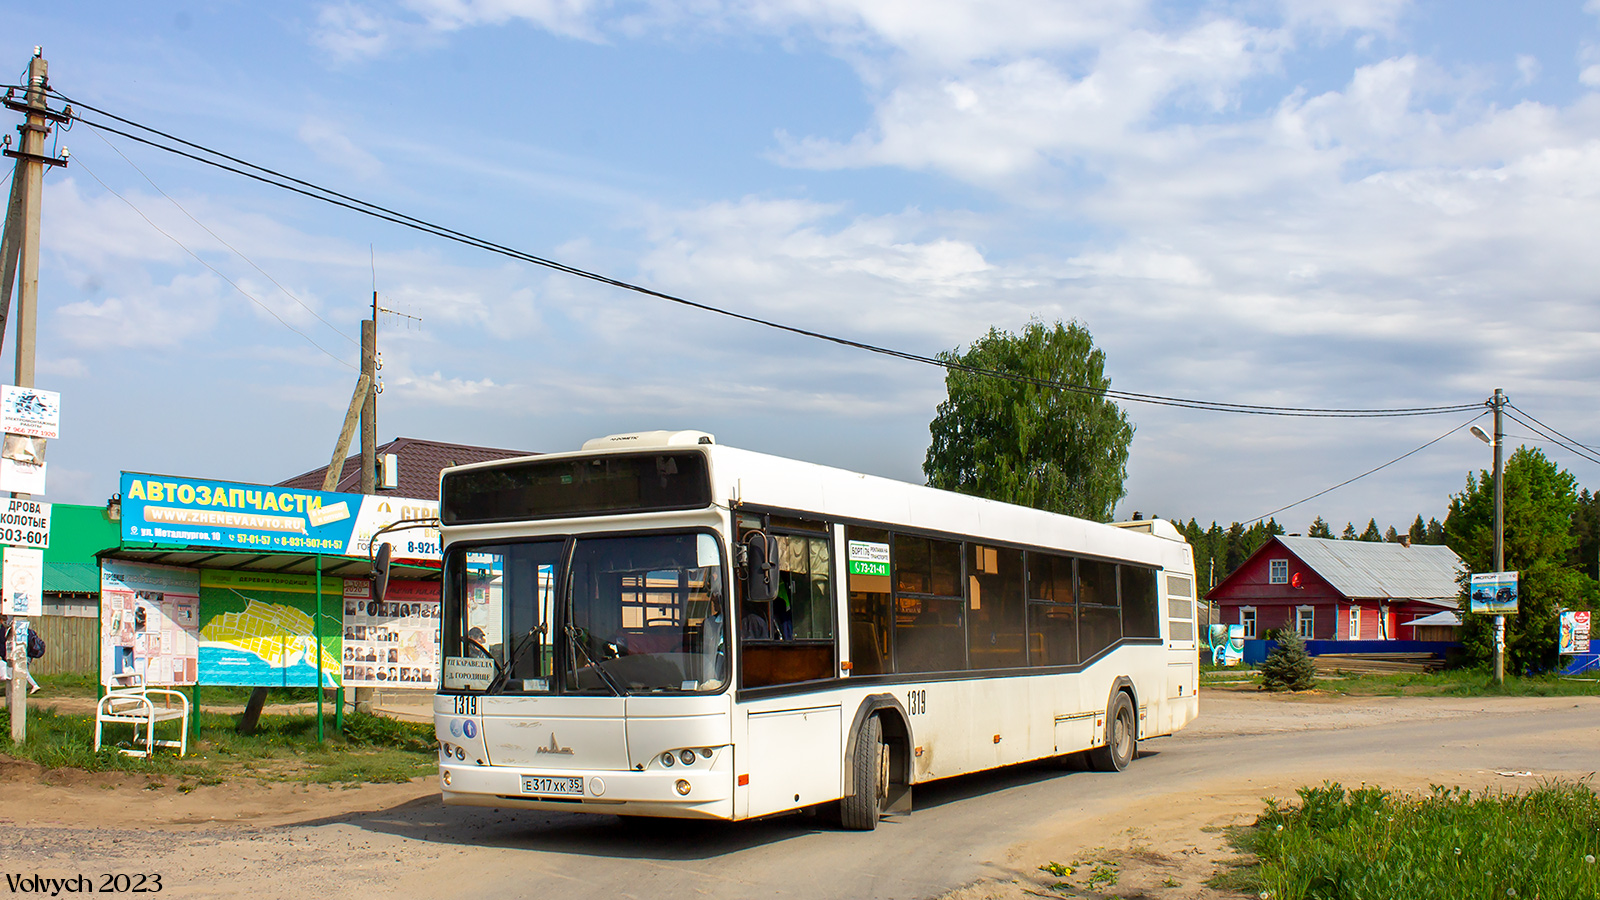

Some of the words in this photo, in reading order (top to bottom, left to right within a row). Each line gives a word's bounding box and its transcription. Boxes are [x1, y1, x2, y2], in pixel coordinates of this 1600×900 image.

[41, 430, 57, 438] 1920
[127, 479, 322, 514] АВТОЗАПЧАСТИ
[8, 500, 41, 514] ДРОВА
[0, 513, 47, 529] КОЛОТЫЕ
[151, 508, 301, 530] WWW.ZHENEVAAVTO.RU
[401, 505, 439, 525] СТРА
[211, 532, 221, 541] 10
[237, 534, 271, 545] 57-01-57
[280, 536, 343, 550] 8-931-507-01-57
[861, 562, 886, 575] 73-21-41
[271, 578, 308, 586] ГОРОДИЩЕ
[453, 695, 477, 715] 1319
[907, 689, 926, 716] 1319
